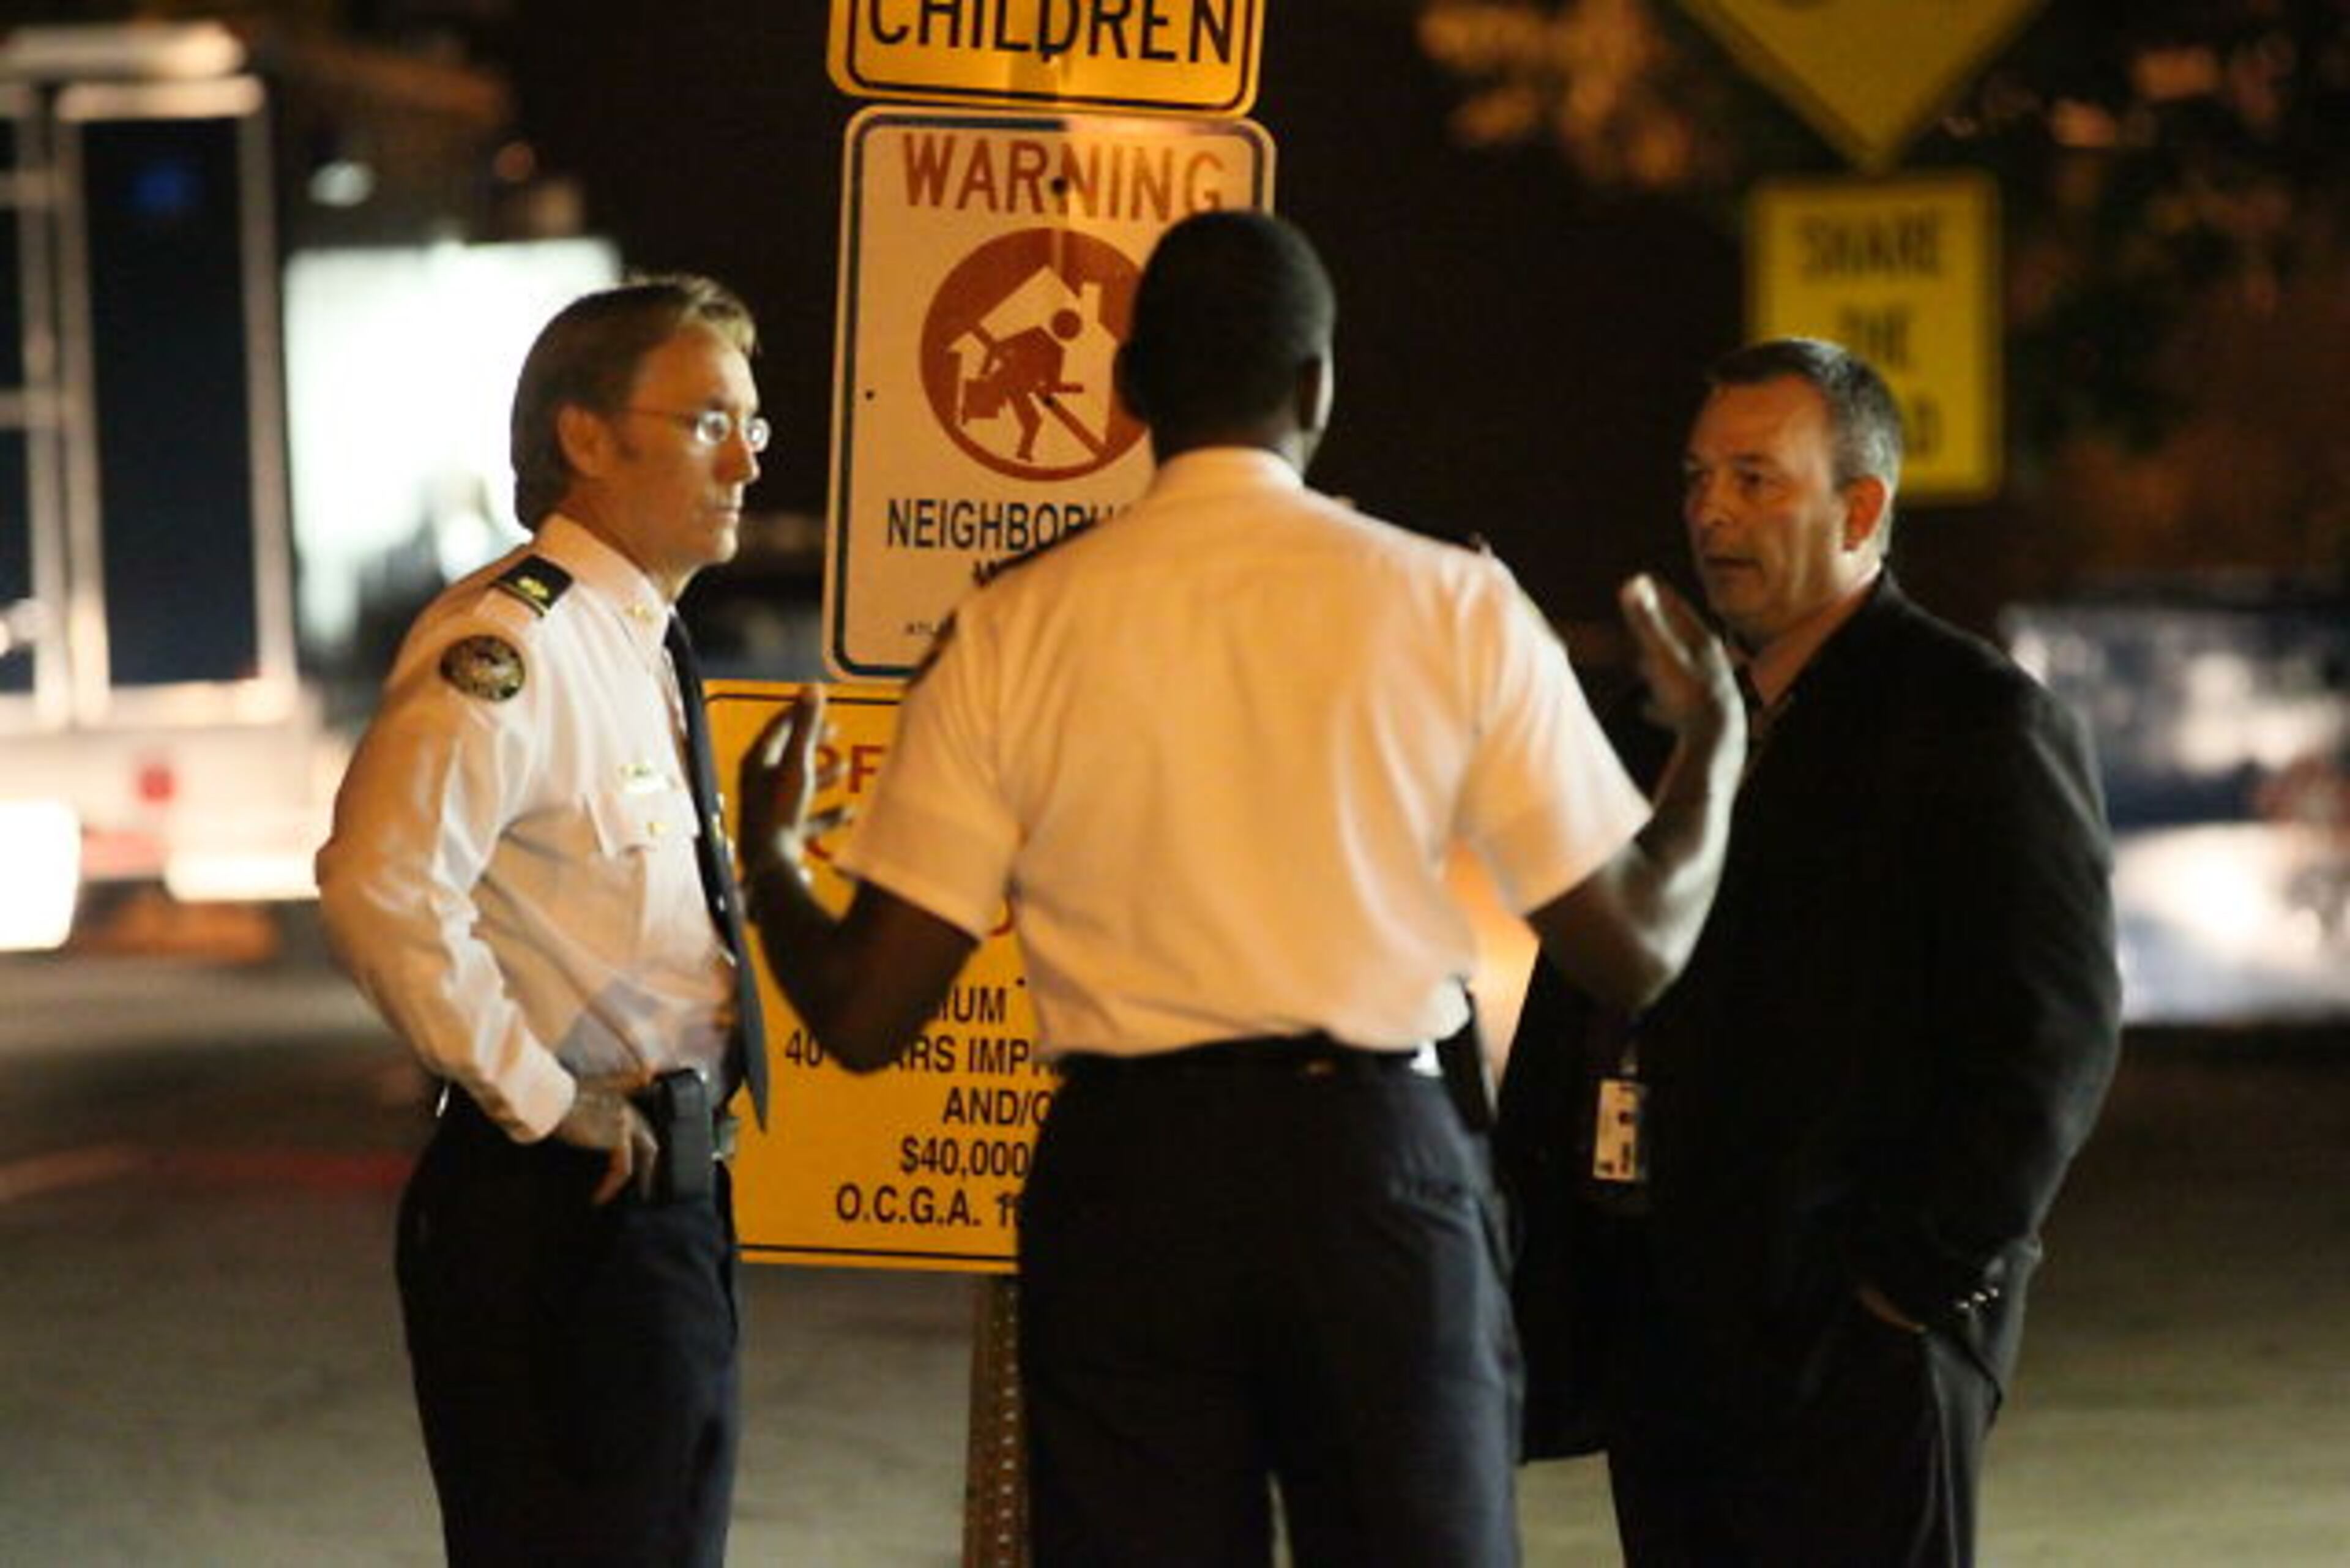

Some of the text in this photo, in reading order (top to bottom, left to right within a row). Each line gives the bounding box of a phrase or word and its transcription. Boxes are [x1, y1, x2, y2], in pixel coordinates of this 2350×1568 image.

[869, 0, 1233, 64] CHILDREN
[901, 133, 1226, 223] WARNING
[886, 498, 1115, 551] NEIGHBOR
[968, 1037, 1060, 1077] IMP
[942, 1086, 1055, 1128] AND/O
[900, 1135, 1031, 1180] $40,000
[835, 1182, 983, 1227] O.C.G.A.
